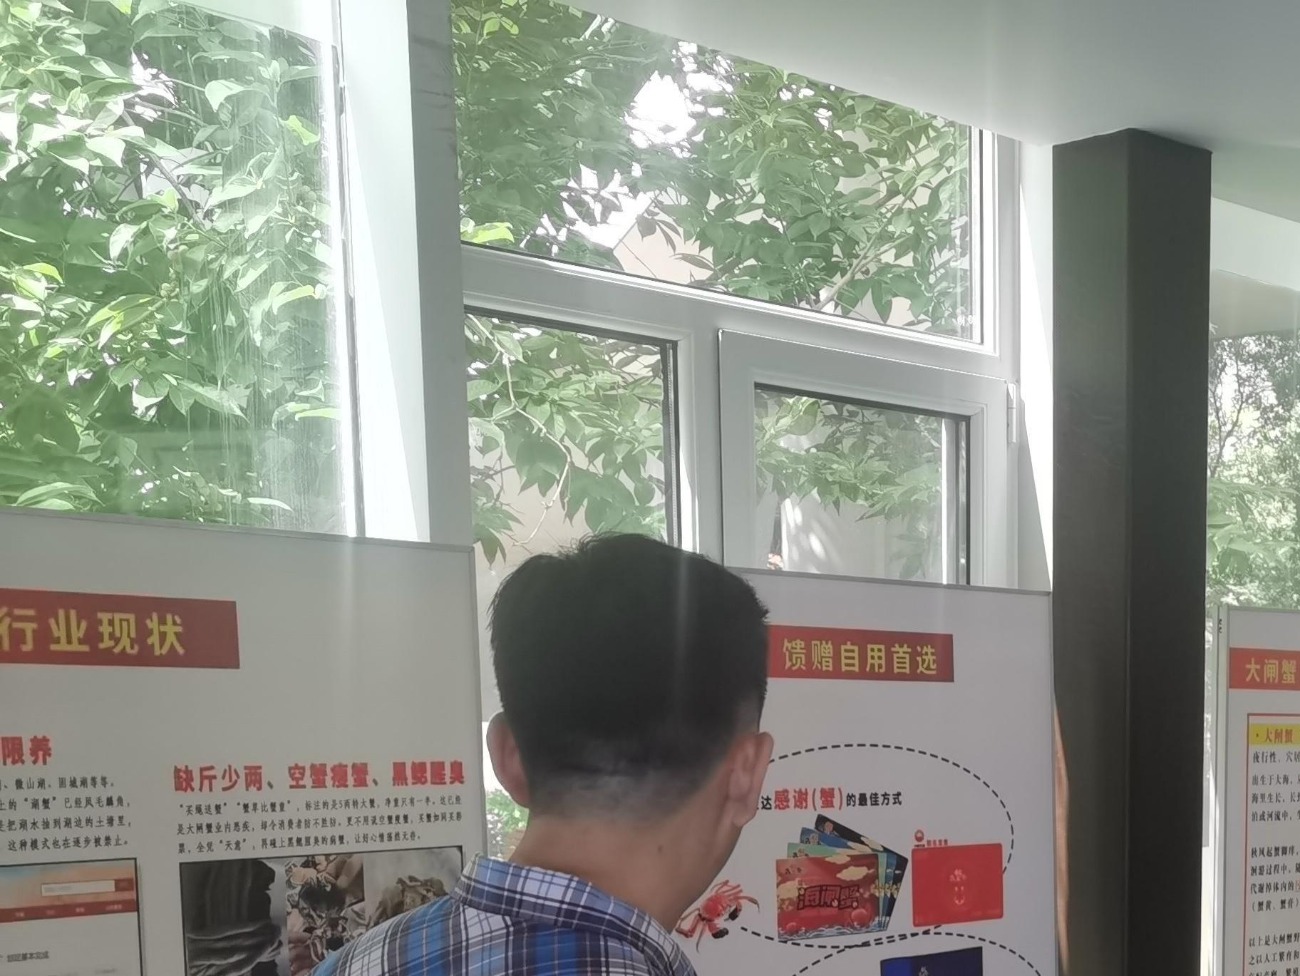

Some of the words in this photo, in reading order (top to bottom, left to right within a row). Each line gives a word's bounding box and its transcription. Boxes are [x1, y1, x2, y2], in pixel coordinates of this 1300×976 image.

[0, 607, 186, 656] 行业现状
[782, 638, 938, 675] 馈赠自用首选
[1, 735, 52, 767] 限养
